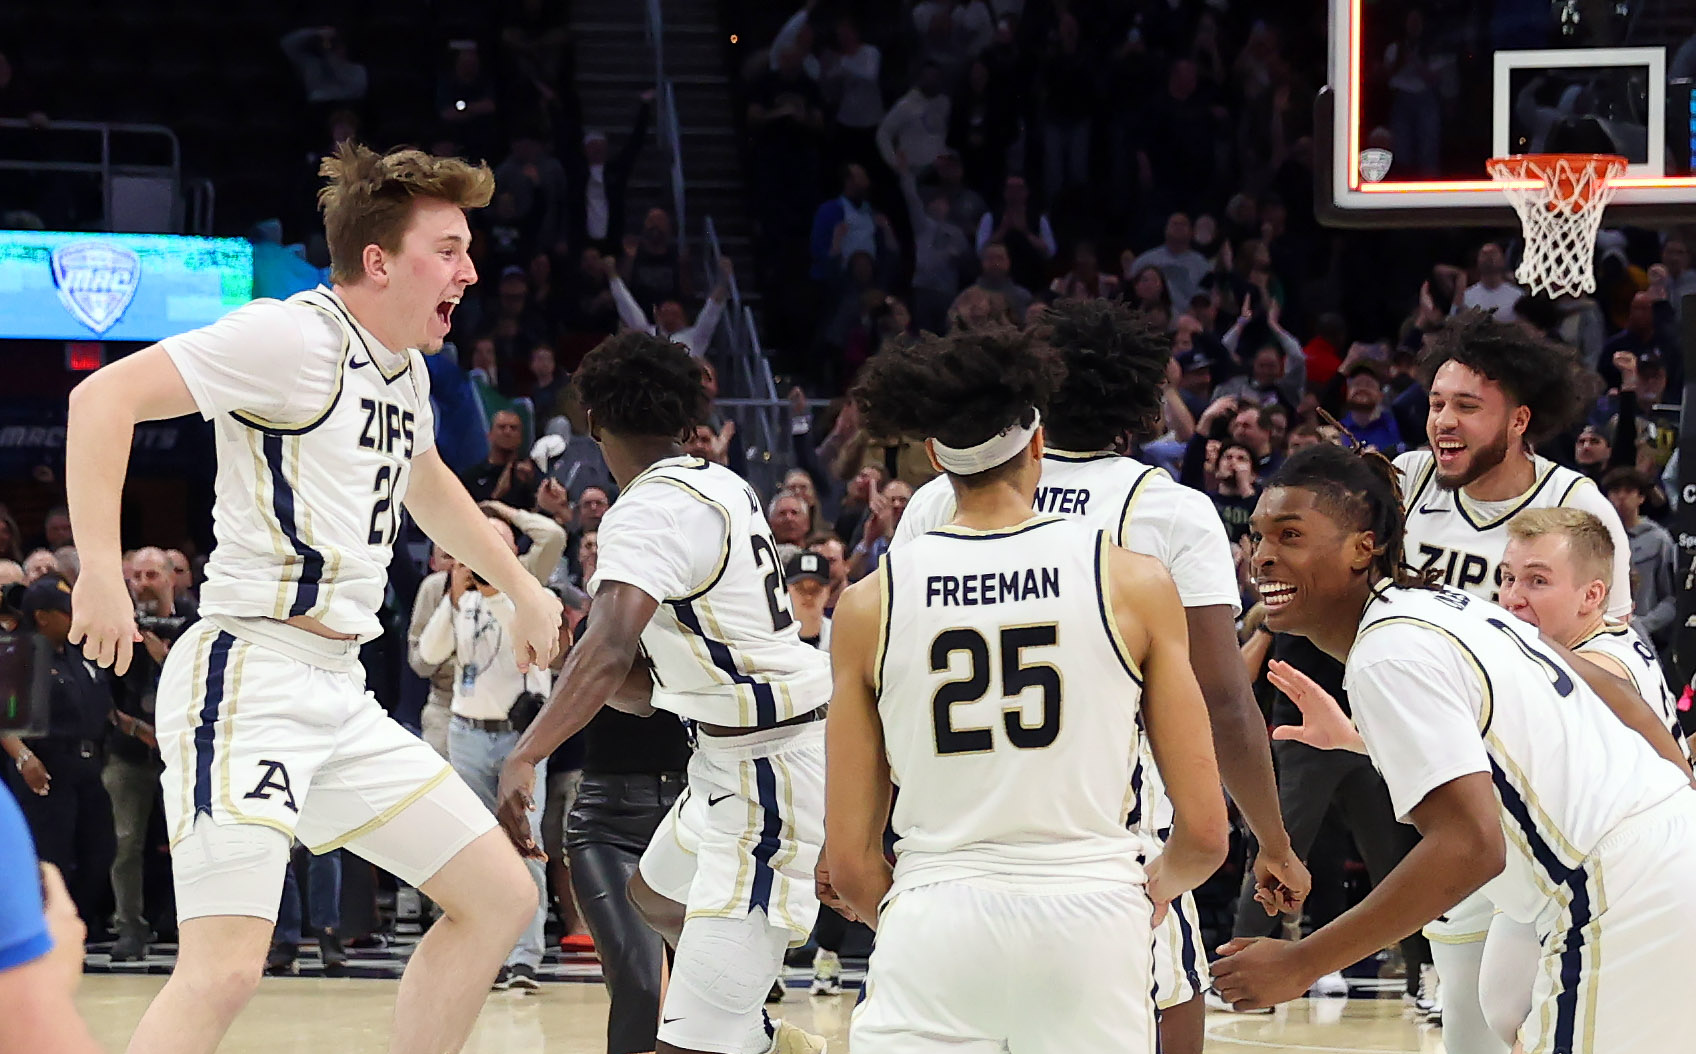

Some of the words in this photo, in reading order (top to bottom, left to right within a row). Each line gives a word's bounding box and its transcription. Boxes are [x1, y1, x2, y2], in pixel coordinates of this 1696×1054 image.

[358, 397, 415, 461] ZIPS
[1031, 487, 1091, 515] NTER
[926, 567, 1061, 608] FREEMAN
[1419, 544, 1502, 595] ZIP
[928, 620, 1065, 757] 25
[244, 759, 299, 814] A
